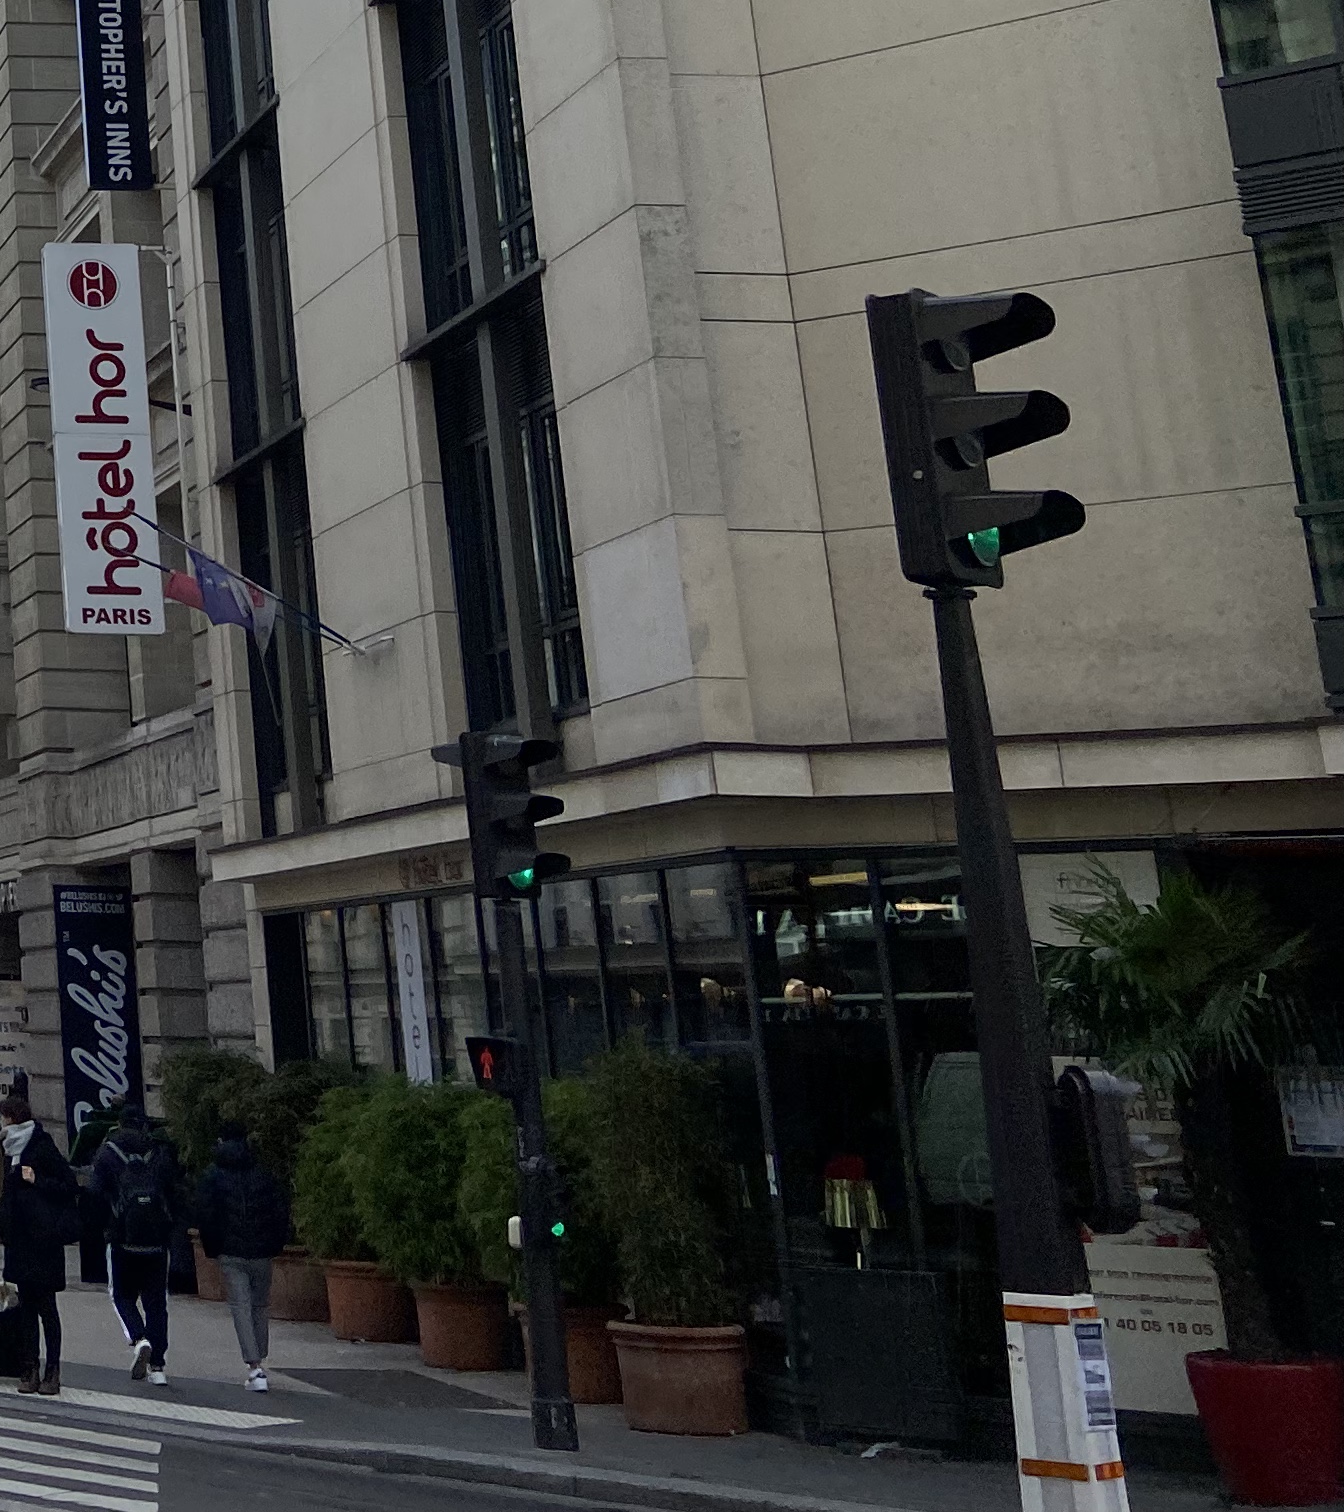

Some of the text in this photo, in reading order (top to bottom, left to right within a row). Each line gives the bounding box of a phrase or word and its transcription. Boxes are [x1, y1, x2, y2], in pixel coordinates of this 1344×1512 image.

[105, 122, 133, 182] INNS
[74, 328, 143, 595] hôtel hor
[81, 607, 152, 625] PARIS
[1116, 1318, 1137, 1331] 40
[1141, 1320, 1162, 1332] 05
[1167, 1322, 1188, 1335] 18
[1192, 1323, 1214, 1336] 05
